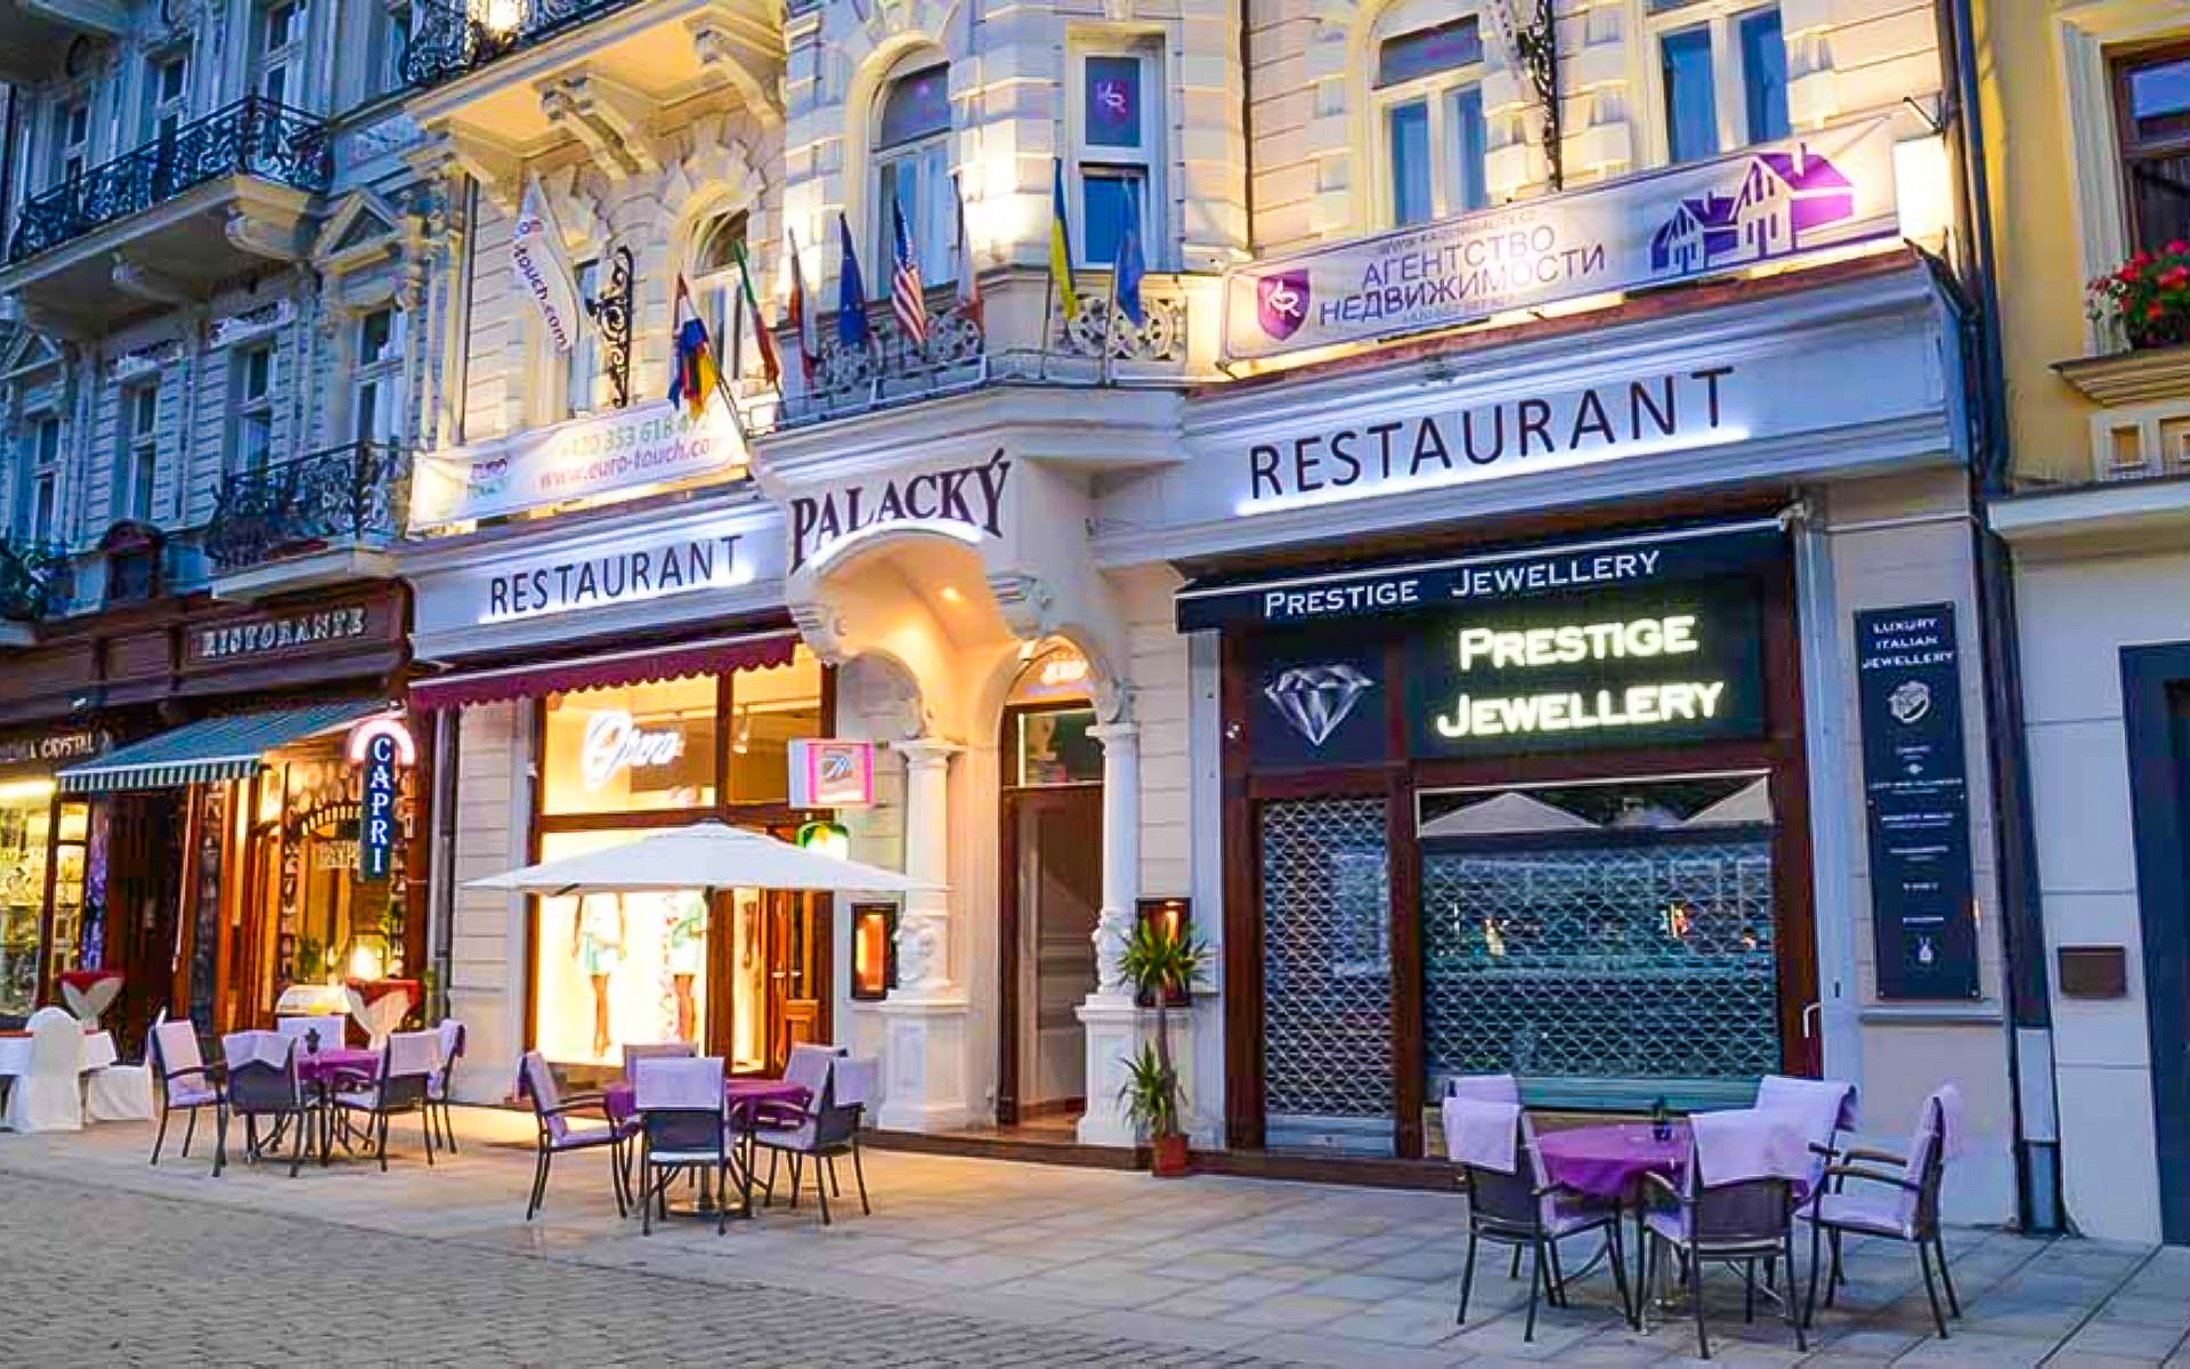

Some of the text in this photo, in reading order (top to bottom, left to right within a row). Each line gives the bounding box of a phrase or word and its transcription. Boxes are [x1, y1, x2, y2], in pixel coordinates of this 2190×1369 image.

[1319, 243, 1606, 327] НЕДВИЖИМОСТИ
[1362, 224, 1556, 290] АГЕНТСТВО
[540, 438, 722, 490] www.euro-touch.co
[604, 426, 636, 451] 353
[640, 417, 673, 442] 618
[1248, 366, 1735, 500] RESTAURANT
[788, 447, 1012, 577] PALACKÝ
[490, 534, 743, 616] RESTAURANT
[1263, 549, 1661, 618] PRESTIGE JEWELLERY
[1457, 614, 1698, 671] PRESTIGE
[1872, 617, 1939, 635] LUXURY
[1875, 634, 1939, 650] ITALIAN
[1862, 650, 1955, 669] JEWELLERY
[1435, 680, 1725, 739] JEWELLERY
[369, 737, 392, 874] CAPRI
